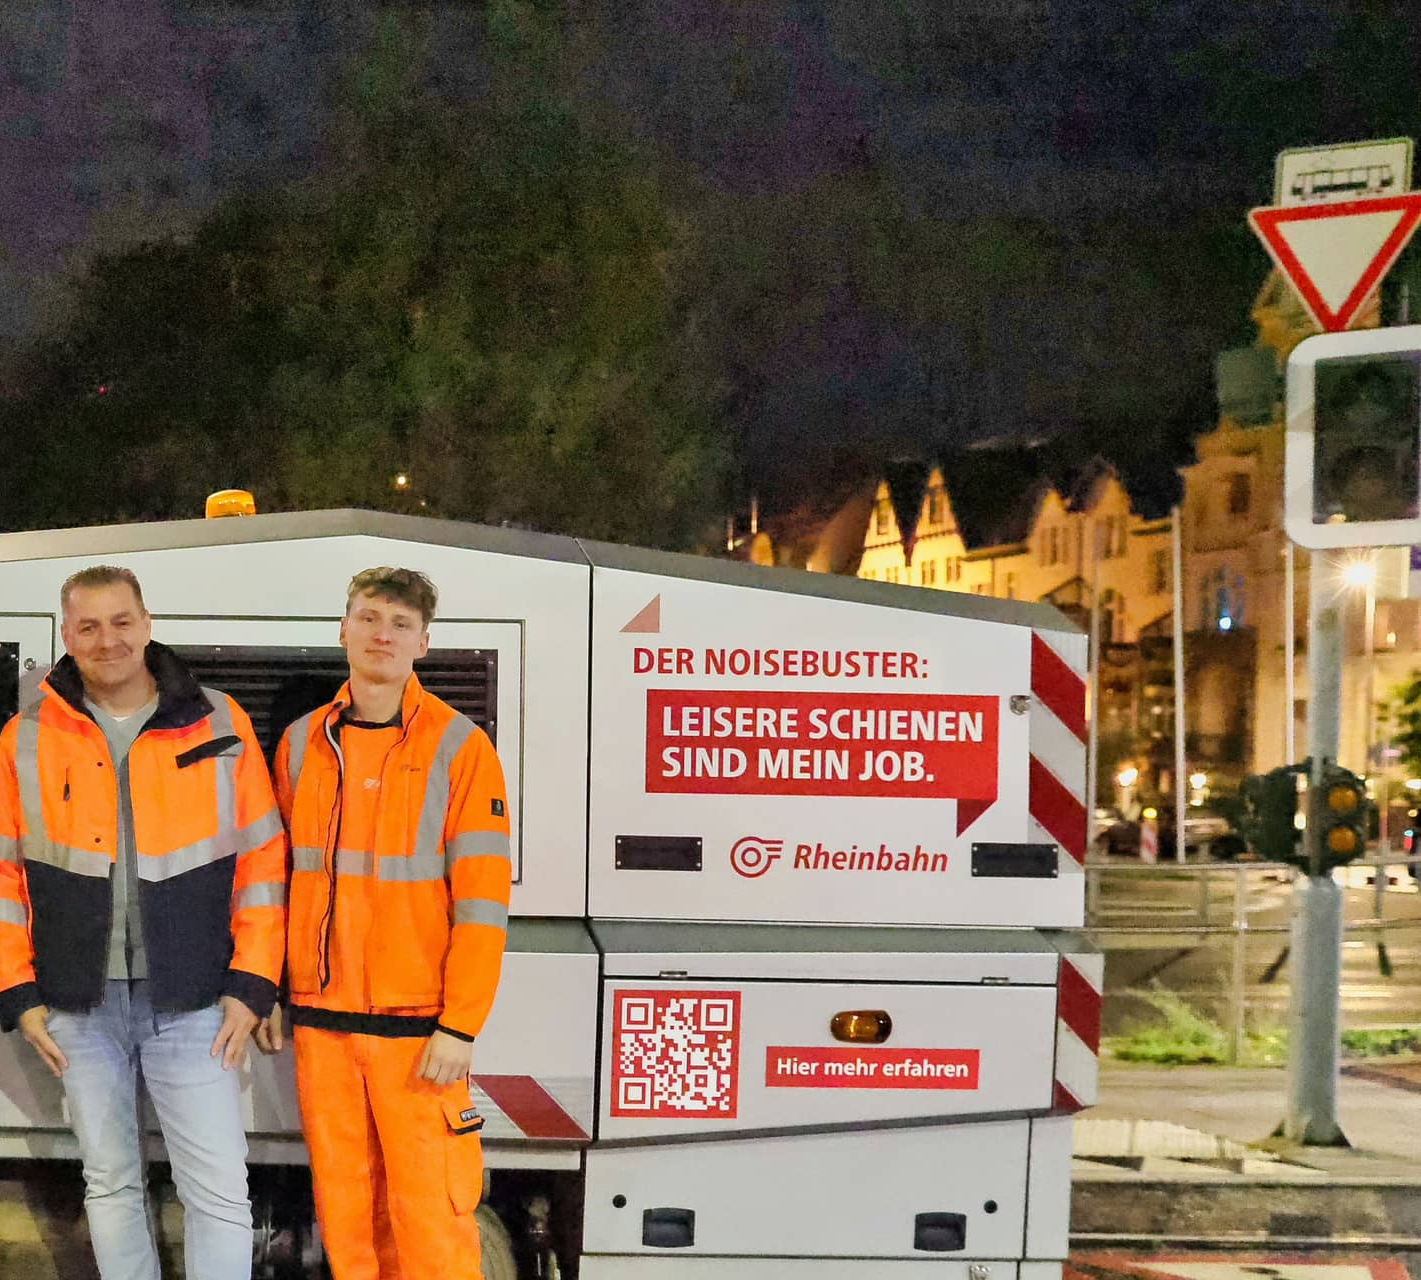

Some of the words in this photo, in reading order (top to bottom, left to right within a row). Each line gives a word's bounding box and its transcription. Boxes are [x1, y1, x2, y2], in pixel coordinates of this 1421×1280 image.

[633, 646, 695, 675] DER
[705, 647, 929, 679] NOISEBUSTER:
[662, 705, 799, 739] LEISERE
[808, 707, 984, 742] SCHIENEN
[661, 745, 748, 778] SIND
[758, 747, 850, 781] MEIN
[858, 749, 936, 783] JOB.
[793, 842, 949, 872] Rheinbahn
[777, 1057, 819, 1075] Hier
[824, 1057, 878, 1076] mehr
[882, 1058, 969, 1078] erfahren
